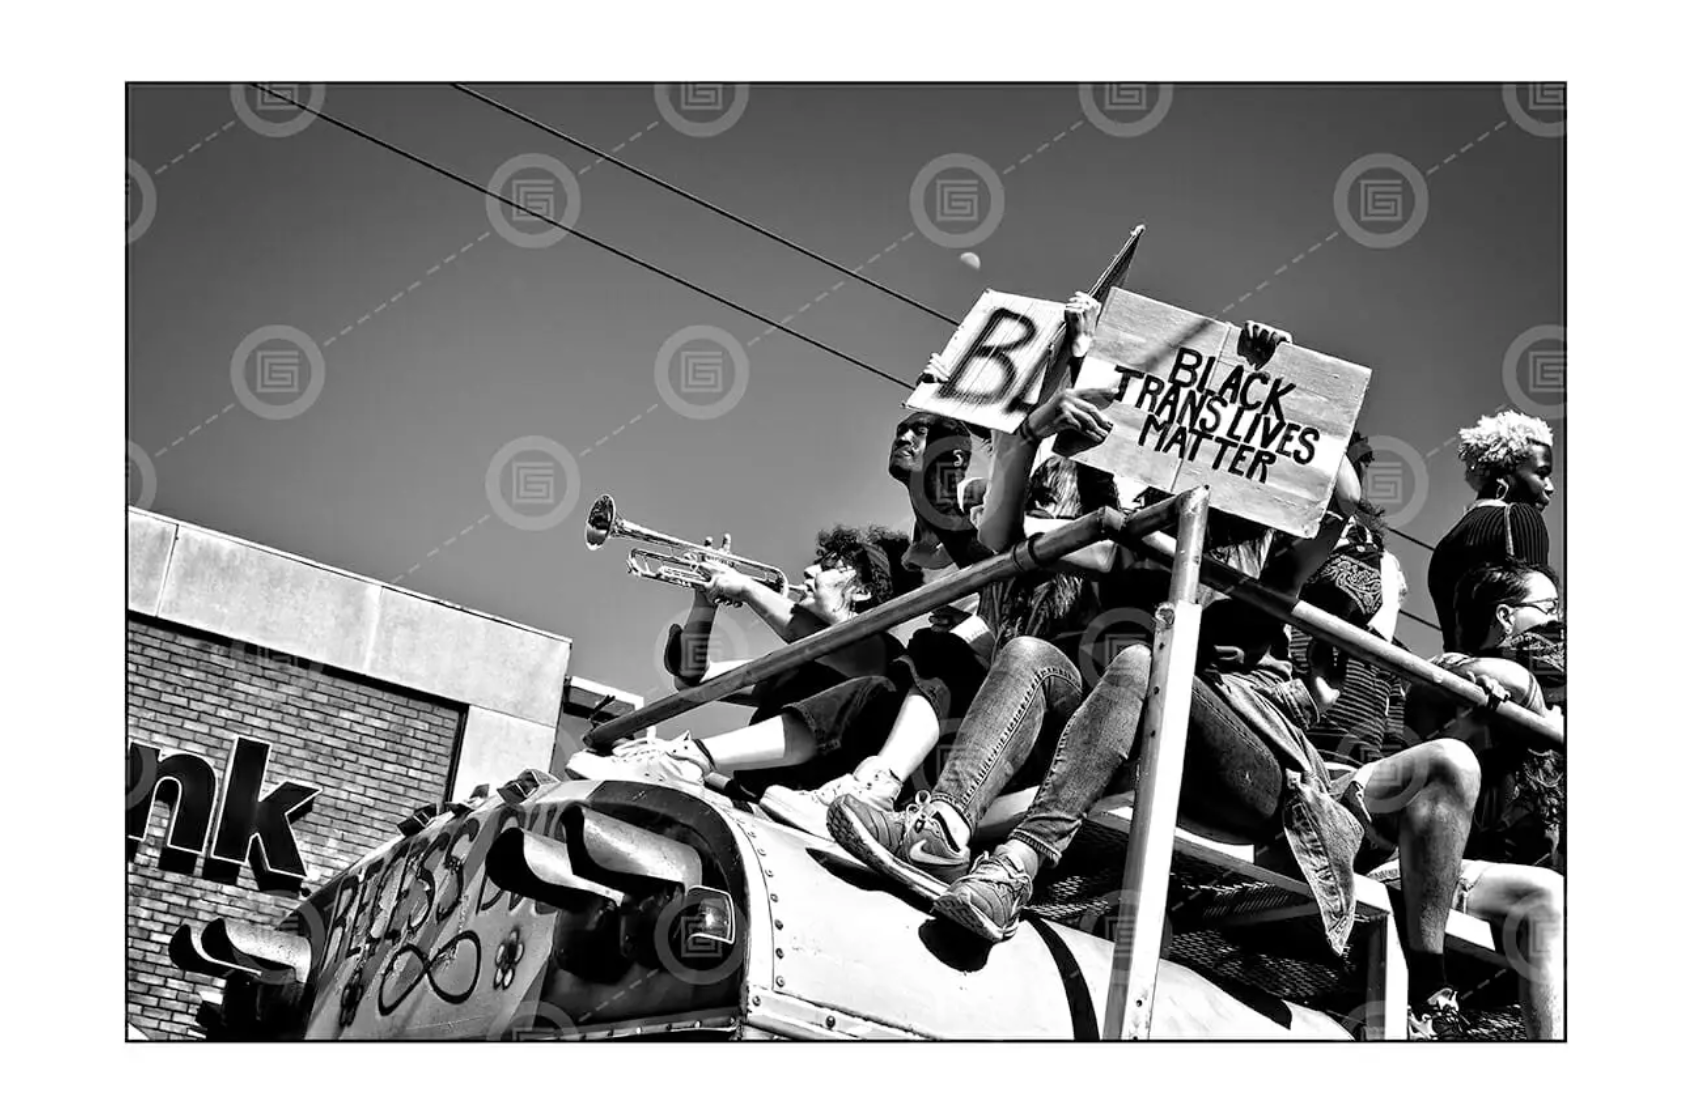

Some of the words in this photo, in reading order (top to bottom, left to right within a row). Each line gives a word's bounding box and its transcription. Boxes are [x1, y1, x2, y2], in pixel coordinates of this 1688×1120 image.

[1114, 364, 1228, 433] TRANS
[1226, 407, 1320, 465] LIVES
[1168, 347, 1296, 422] BLACK
[1138, 413, 1277, 484] MATTER
